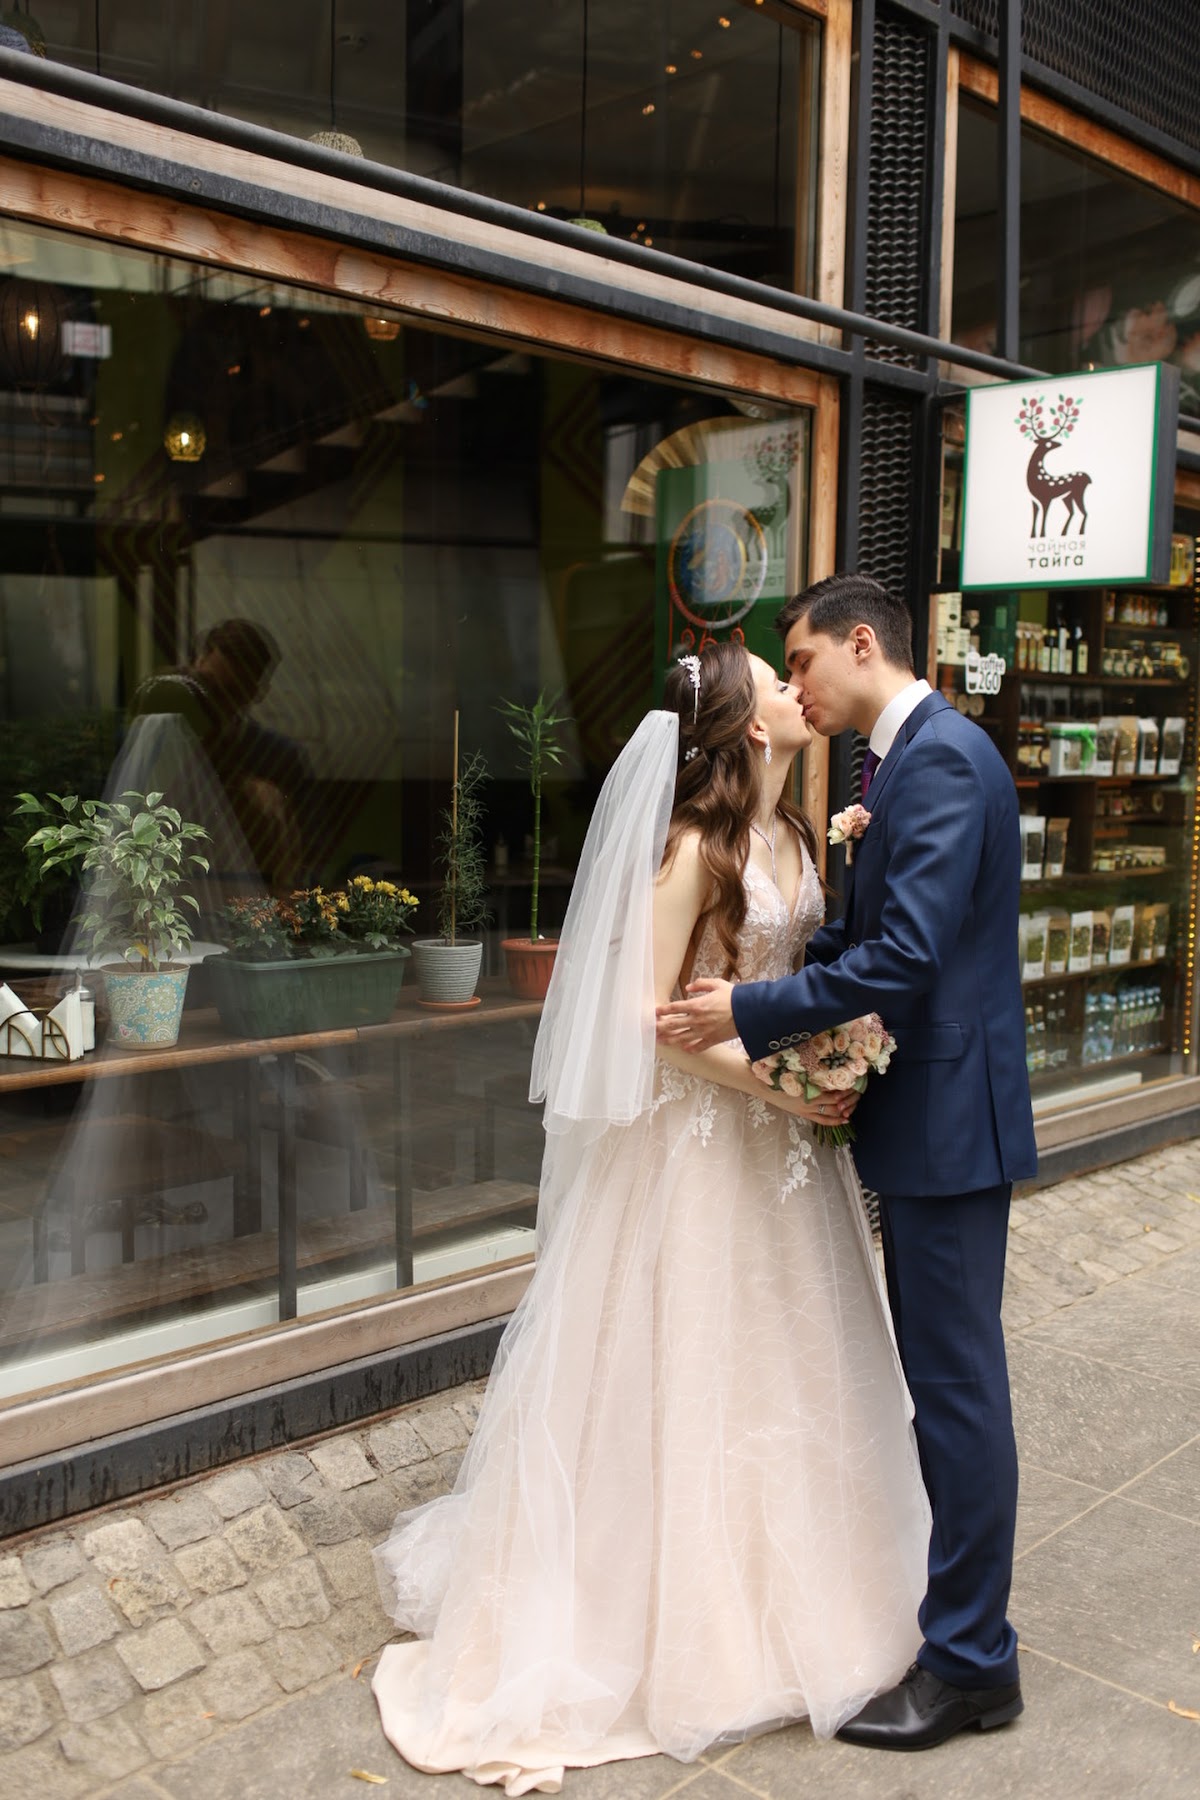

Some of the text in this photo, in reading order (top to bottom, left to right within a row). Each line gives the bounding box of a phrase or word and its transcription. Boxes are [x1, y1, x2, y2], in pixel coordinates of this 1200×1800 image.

[1027, 538, 1086, 553] чайная
[1028, 552, 1084, 568] тайга
[980, 656, 1004, 671] coffee
[979, 671, 999, 690] 2GO
